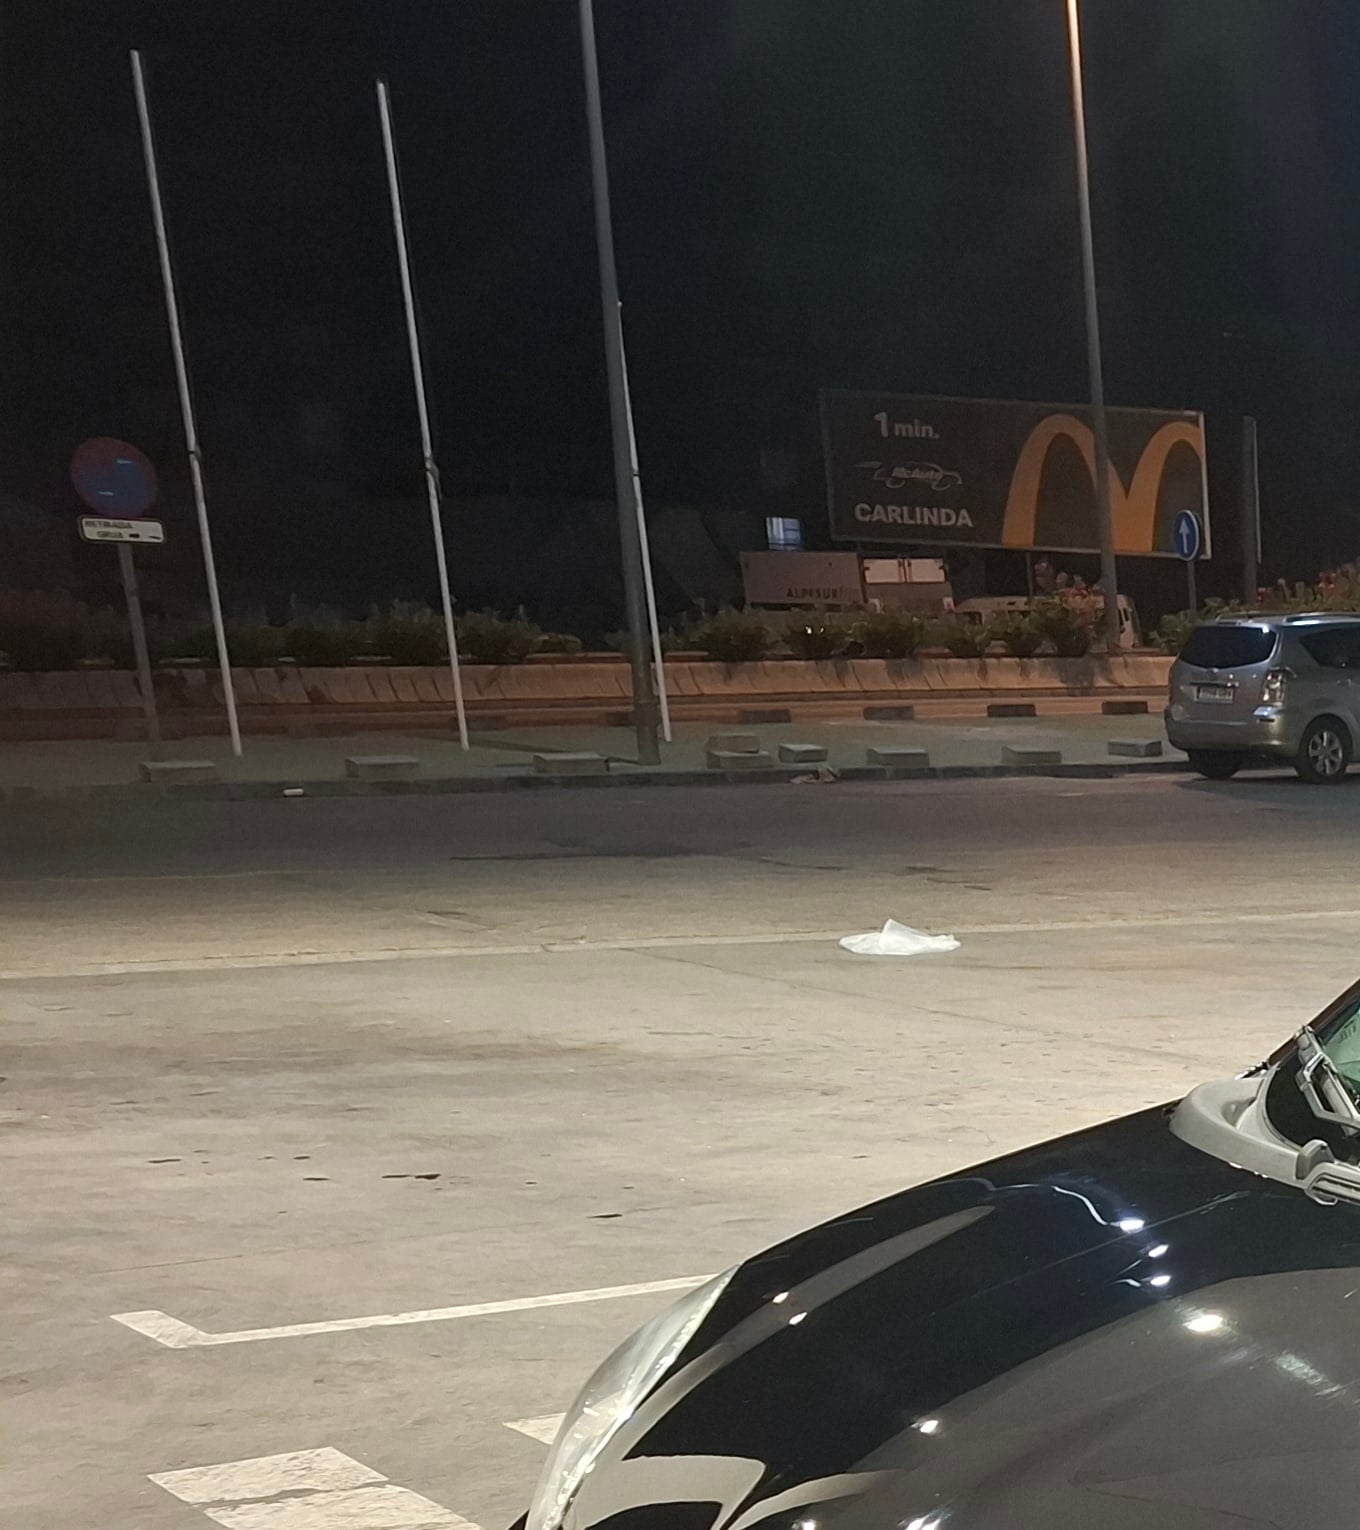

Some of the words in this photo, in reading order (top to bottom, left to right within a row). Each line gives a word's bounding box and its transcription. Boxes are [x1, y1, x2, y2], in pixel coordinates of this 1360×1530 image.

[873, 411, 889, 438] 1
[894, 418, 940, 439] min.
[854, 503, 975, 527] CARLINDA
